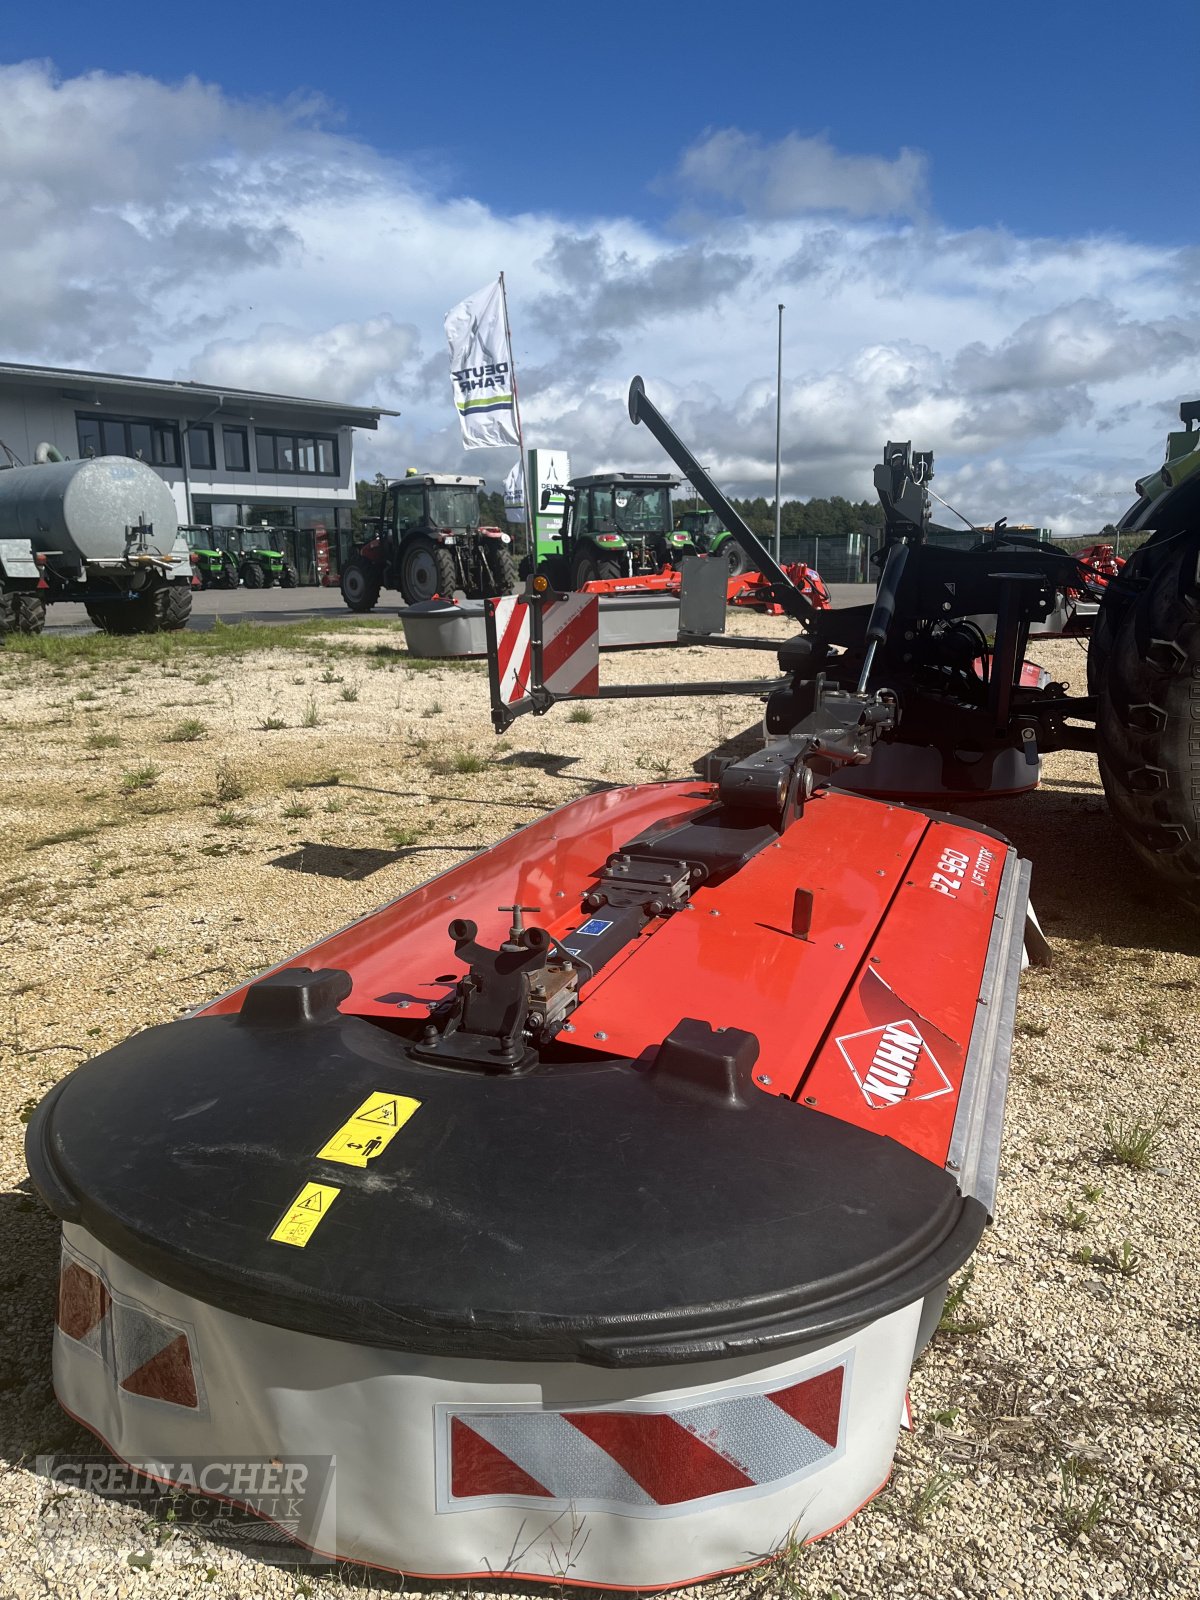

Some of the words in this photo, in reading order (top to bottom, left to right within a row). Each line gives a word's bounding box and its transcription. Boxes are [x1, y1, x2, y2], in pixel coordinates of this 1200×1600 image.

[937, 847, 970, 878] 960
[929, 872, 961, 899] PZ
[970, 869, 987, 887] LIFT
[861, 1025, 924, 1103] KUHN
